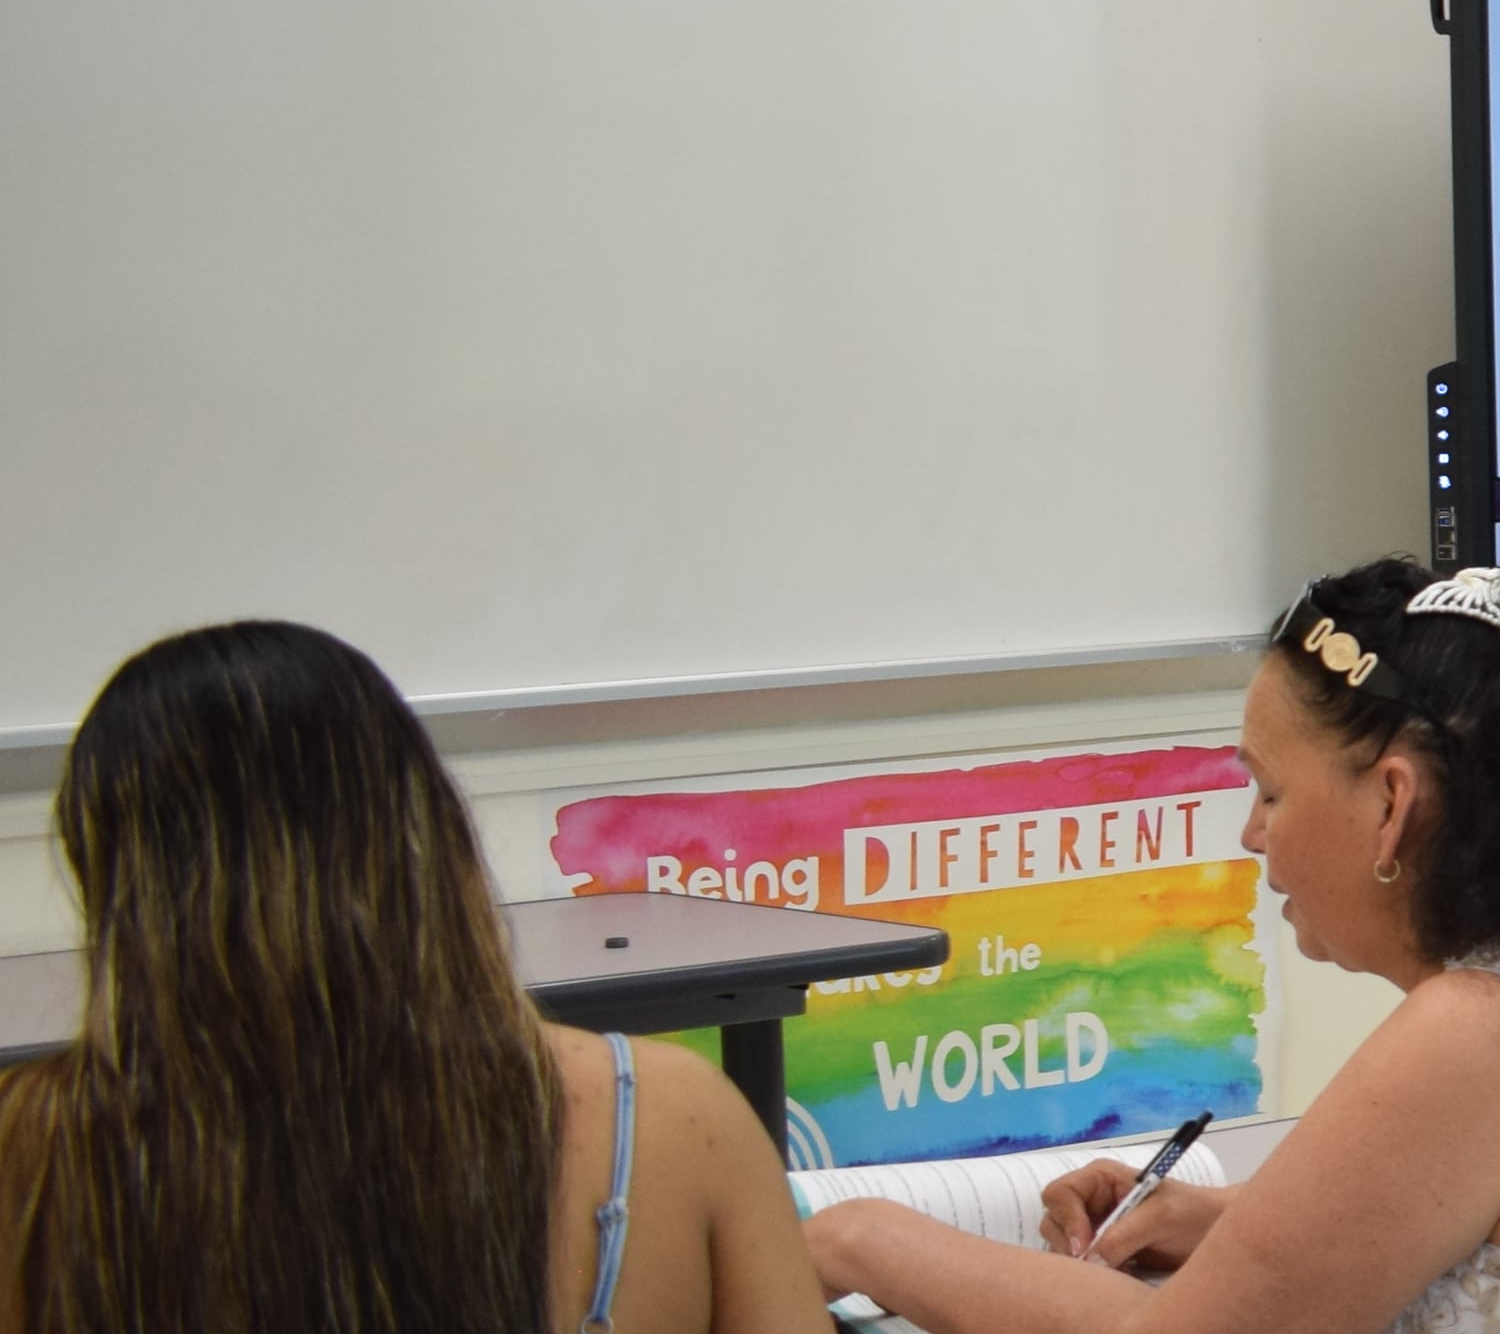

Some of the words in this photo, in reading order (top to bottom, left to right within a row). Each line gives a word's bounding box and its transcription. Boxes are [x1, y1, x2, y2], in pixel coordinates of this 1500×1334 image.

[648, 850, 819, 912] Being
[866, 801, 1201, 896] DIFFERENT
[978, 935, 1042, 977] the
[873, 1011, 1109, 1112] WORLD
